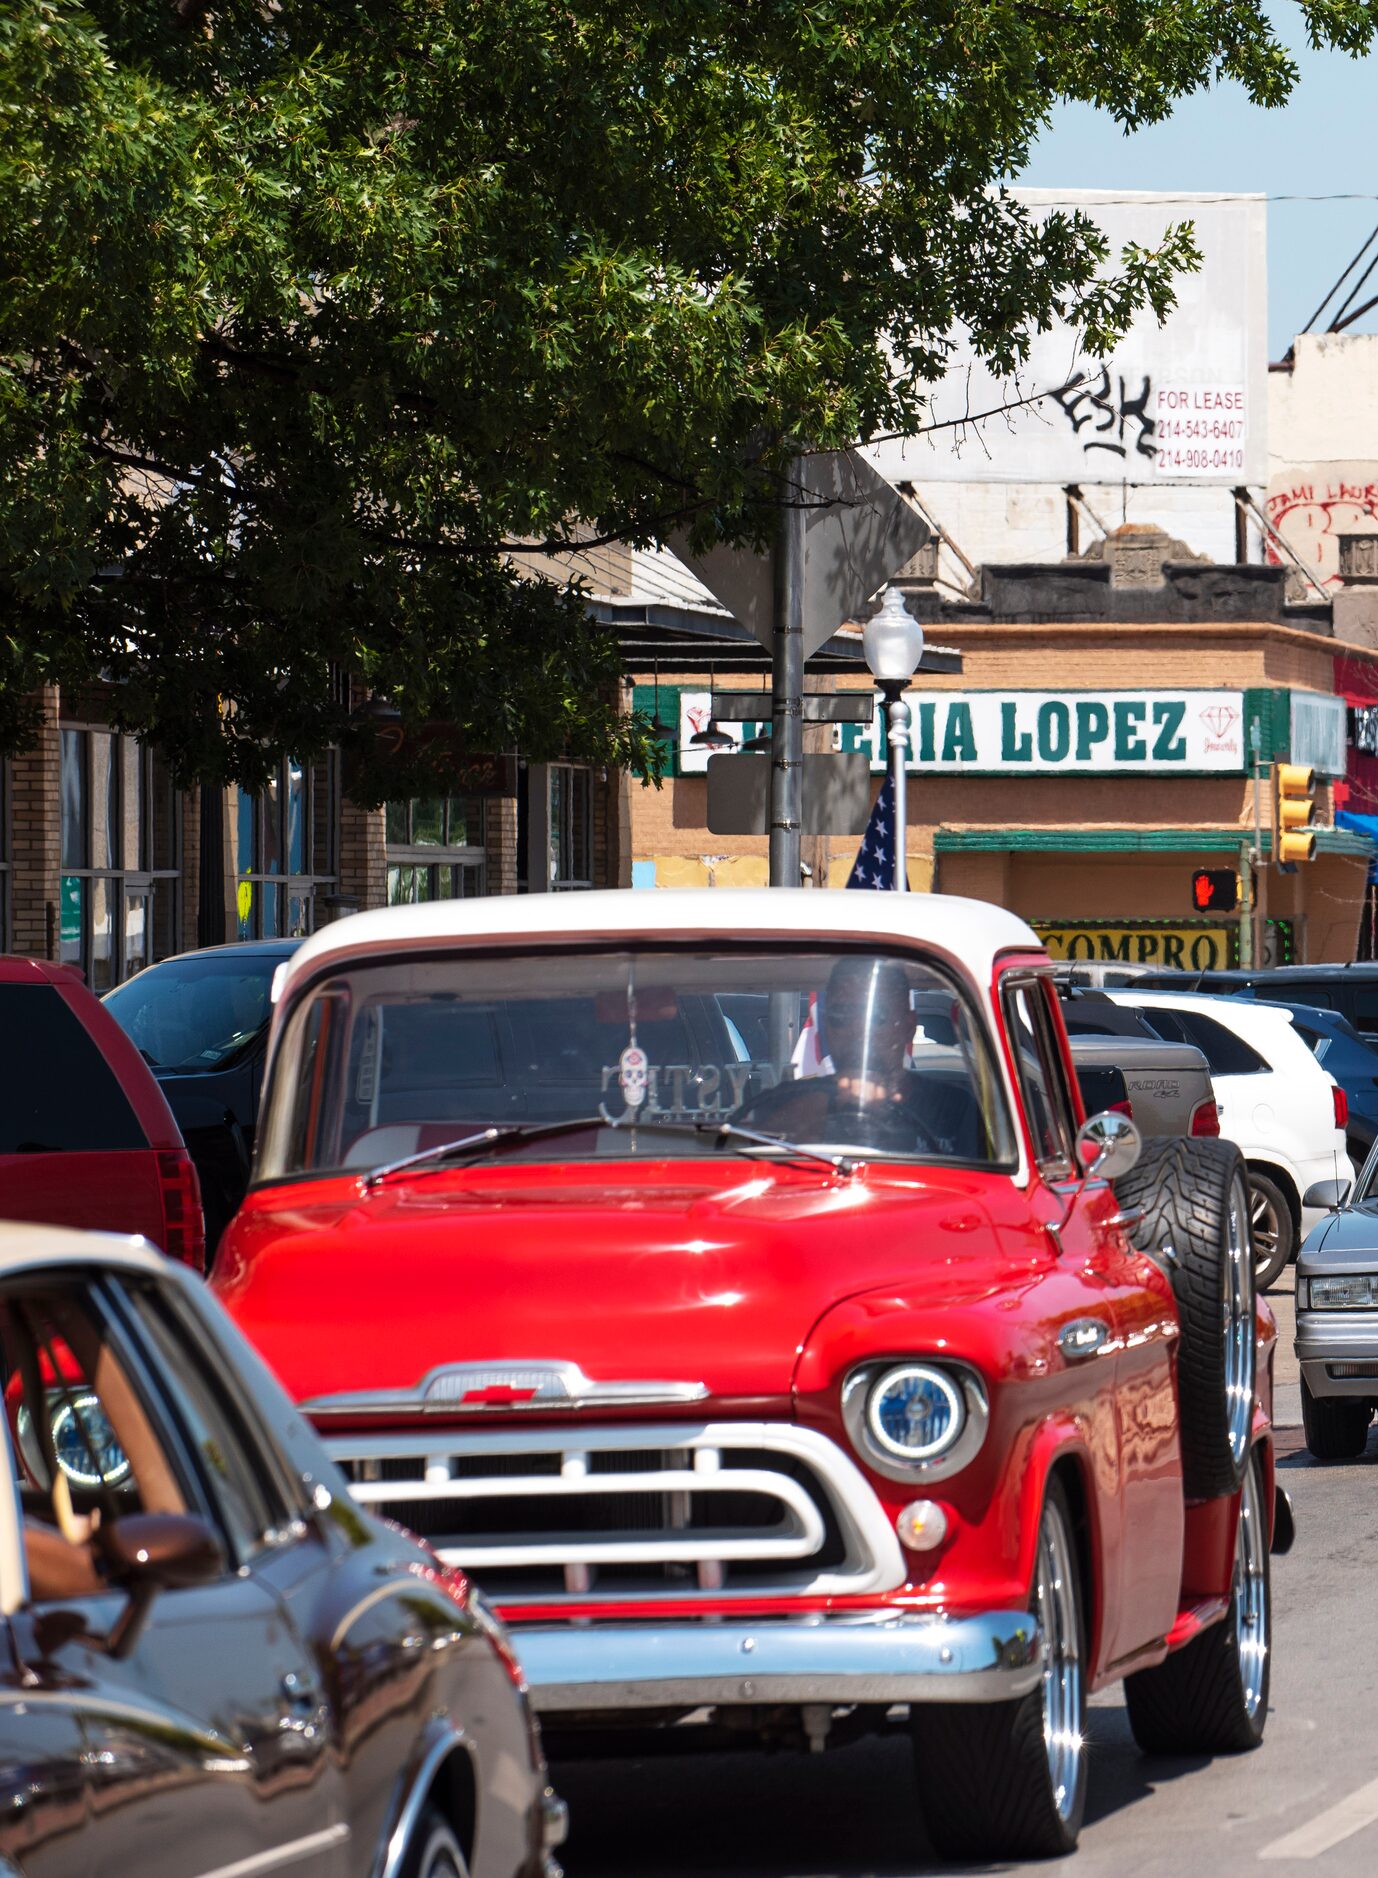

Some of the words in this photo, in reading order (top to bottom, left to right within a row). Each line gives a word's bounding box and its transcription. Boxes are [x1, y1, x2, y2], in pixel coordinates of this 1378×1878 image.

[1157, 391, 1189, 410] FOR
[1194, 391, 1245, 410] LEASE
[1157, 420, 1245, 439] 214-543-6407
[1157, 449, 1244, 468] 214-908-0410
[1000, 700, 1187, 762] LOPEZ
